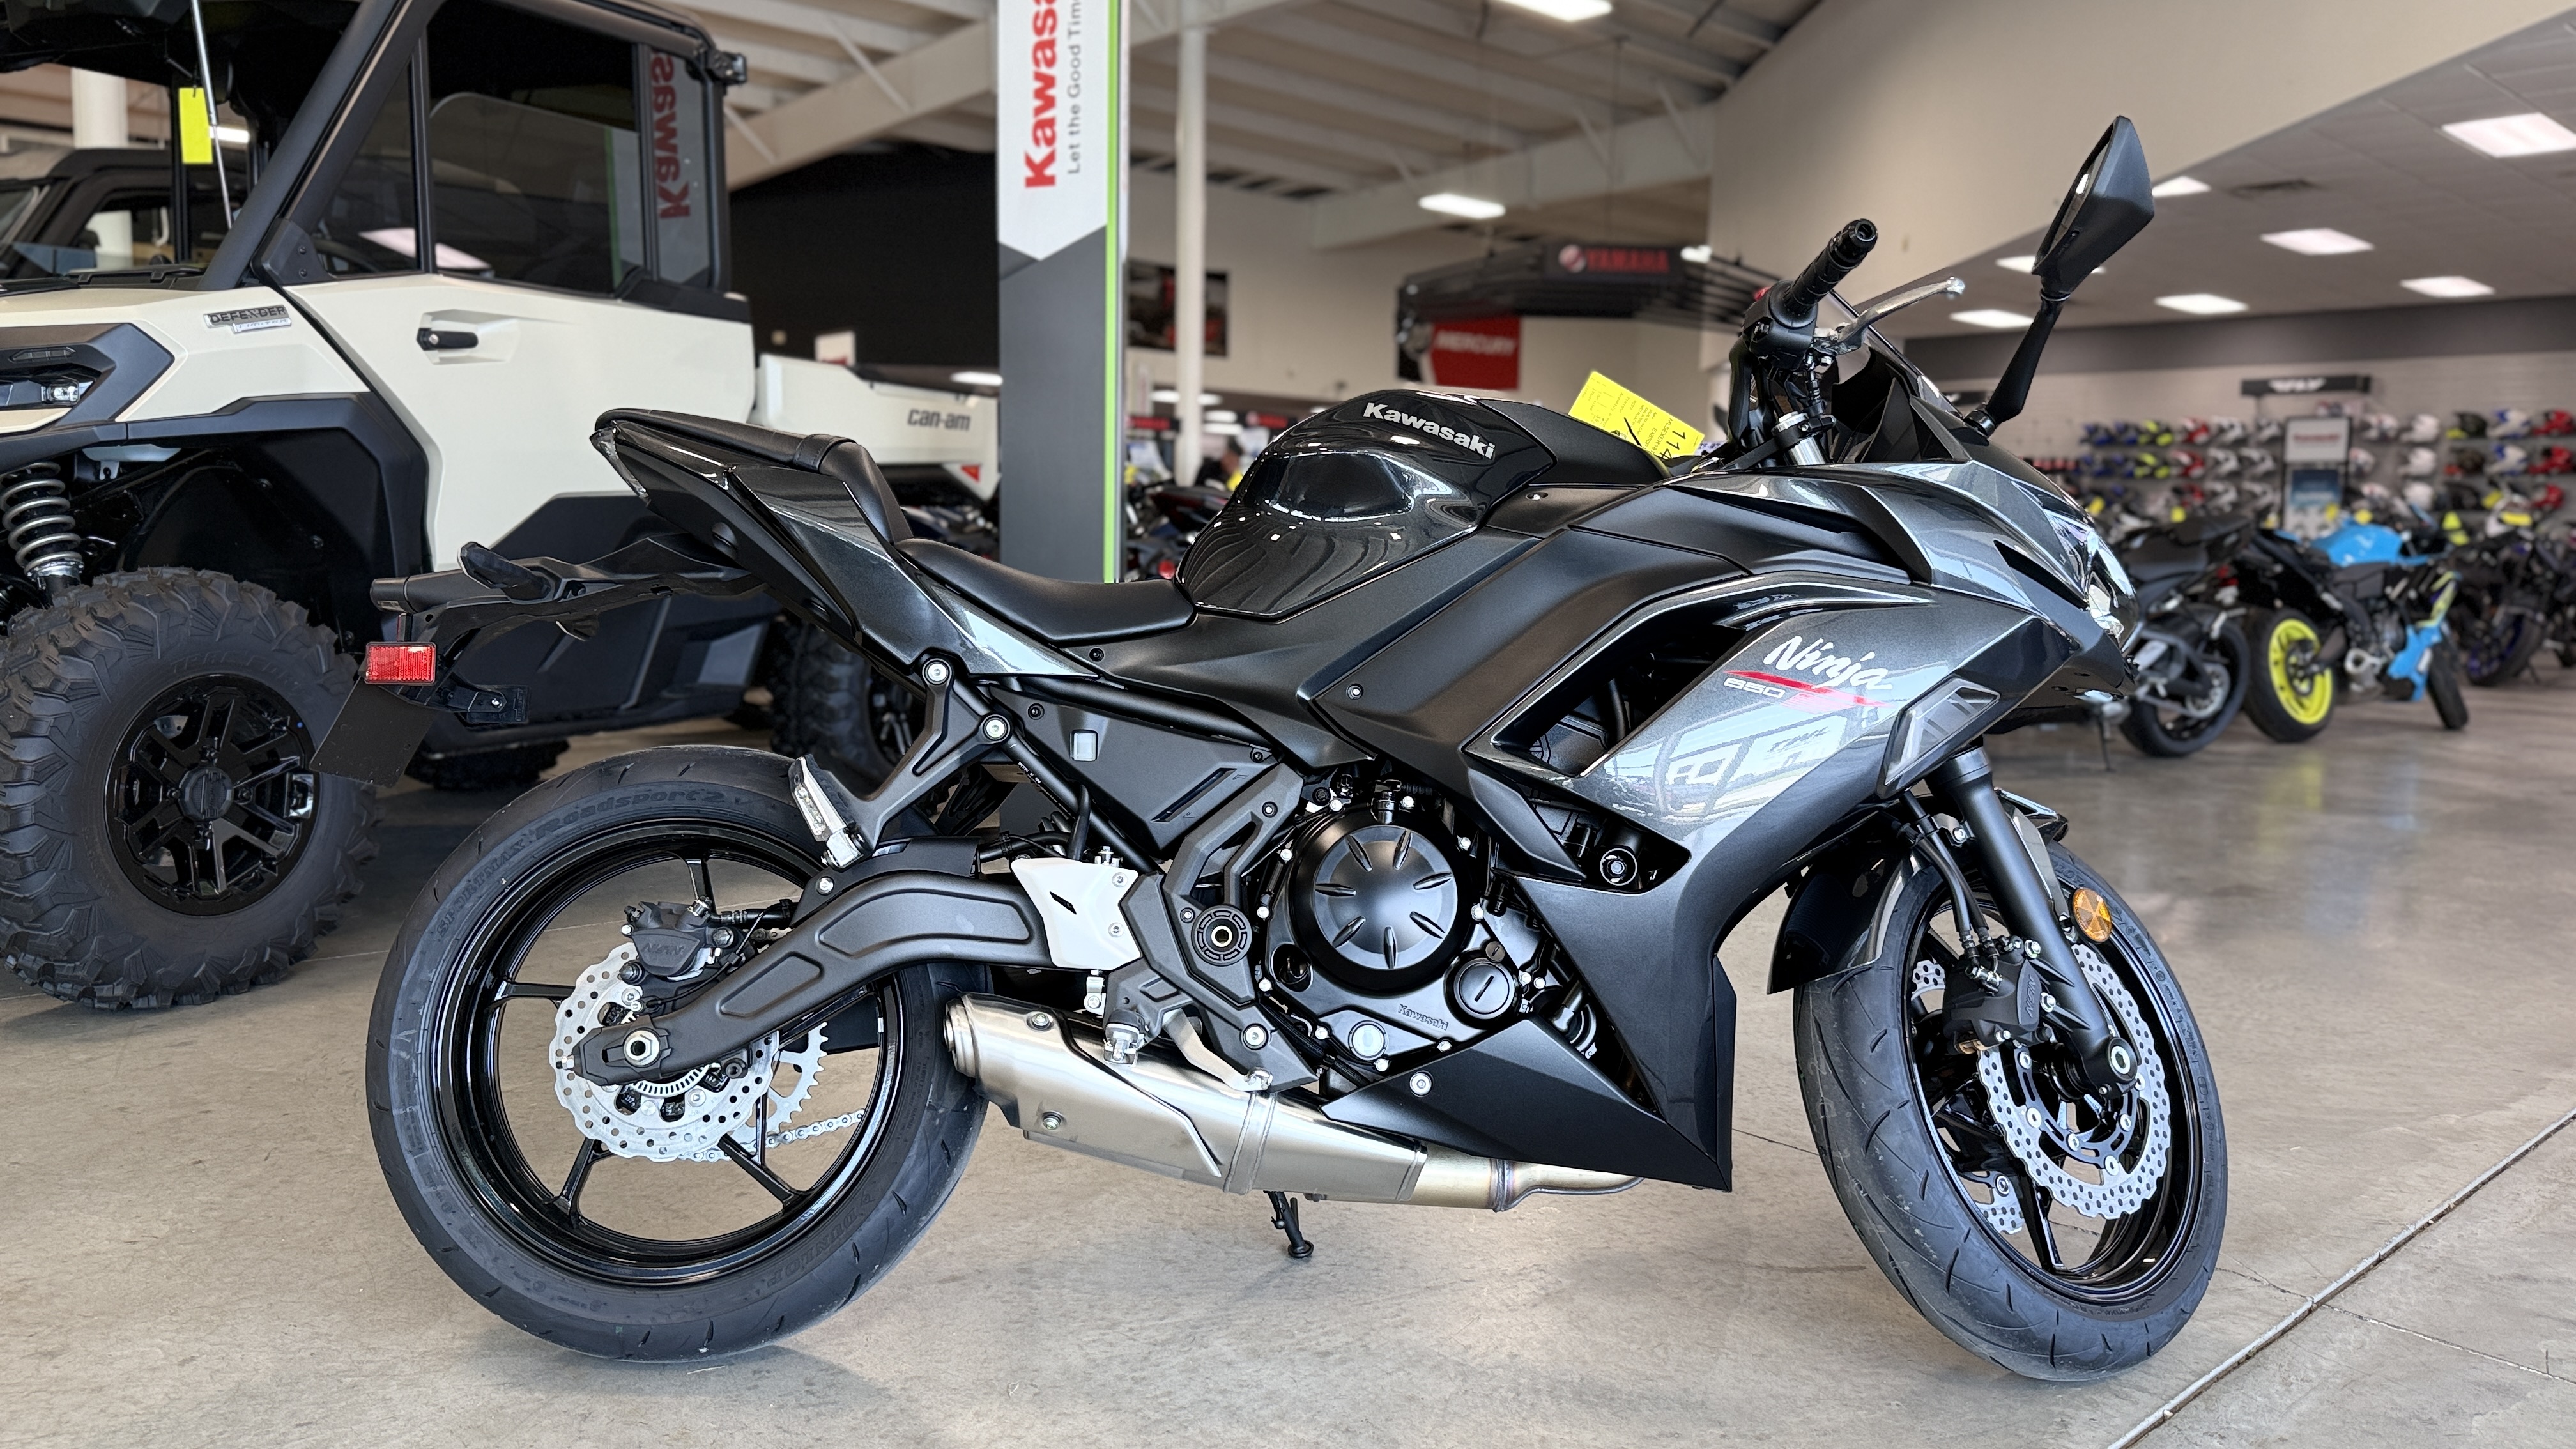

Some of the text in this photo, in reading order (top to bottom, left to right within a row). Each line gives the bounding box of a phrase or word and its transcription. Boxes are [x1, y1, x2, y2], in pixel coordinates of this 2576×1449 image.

[1025, 0, 1057, 187] Kawas
[1068, 0, 1081, 174] Let the Good Tim
[210, 306, 286, 323] DEFENDER
[908, 409, 970, 431] can-am
[1363, 402, 1495, 459] Kawasaki
[1723, 677, 1786, 698] 650
[1763, 636, 1893, 690] Ninja
[434, 838, 528, 937] SPORTMAX
[1398, 1003, 1449, 1031] Kawasaki
[765, 1208, 858, 1287] DUNLOP
